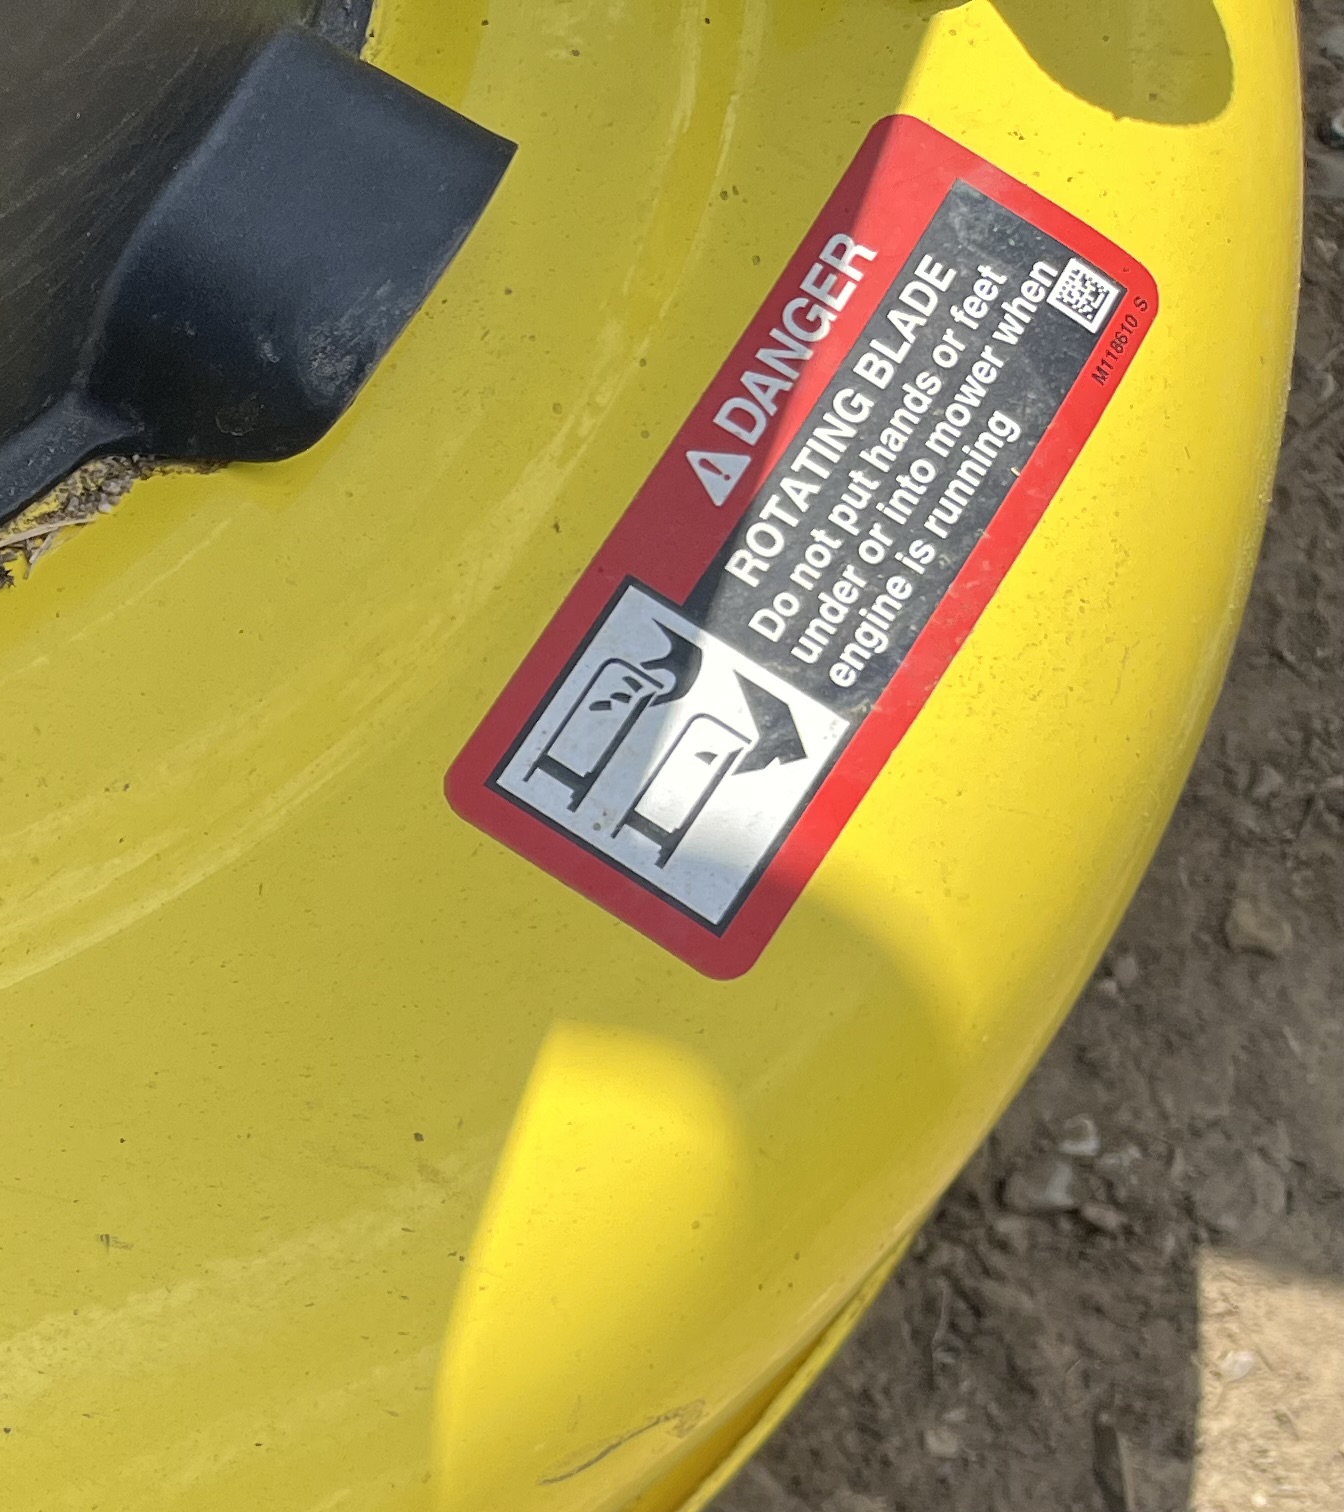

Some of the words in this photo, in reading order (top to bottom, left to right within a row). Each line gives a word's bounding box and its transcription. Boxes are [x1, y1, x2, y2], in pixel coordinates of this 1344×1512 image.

[713, 234, 878, 445] DANGER
[725, 389, 874, 587] ROTATING
[853, 254, 956, 389] BLADE
[749, 592, 800, 642] Do
[790, 529, 842, 590] not
[828, 471, 880, 535] put
[859, 372, 941, 472] hands
[933, 329, 965, 367] or
[950, 265, 1007, 329] feet
[791, 565, 866, 663] under
[859, 523, 893, 563] or
[876, 459, 936, 524] into
[925, 345, 1004, 457] mower
[992, 262, 1058, 344] when
[1091, 313, 1138, 386] M118610
[830, 576, 912, 686] engine
[895, 540, 935, 574] is
[924, 411, 1021, 538] running
